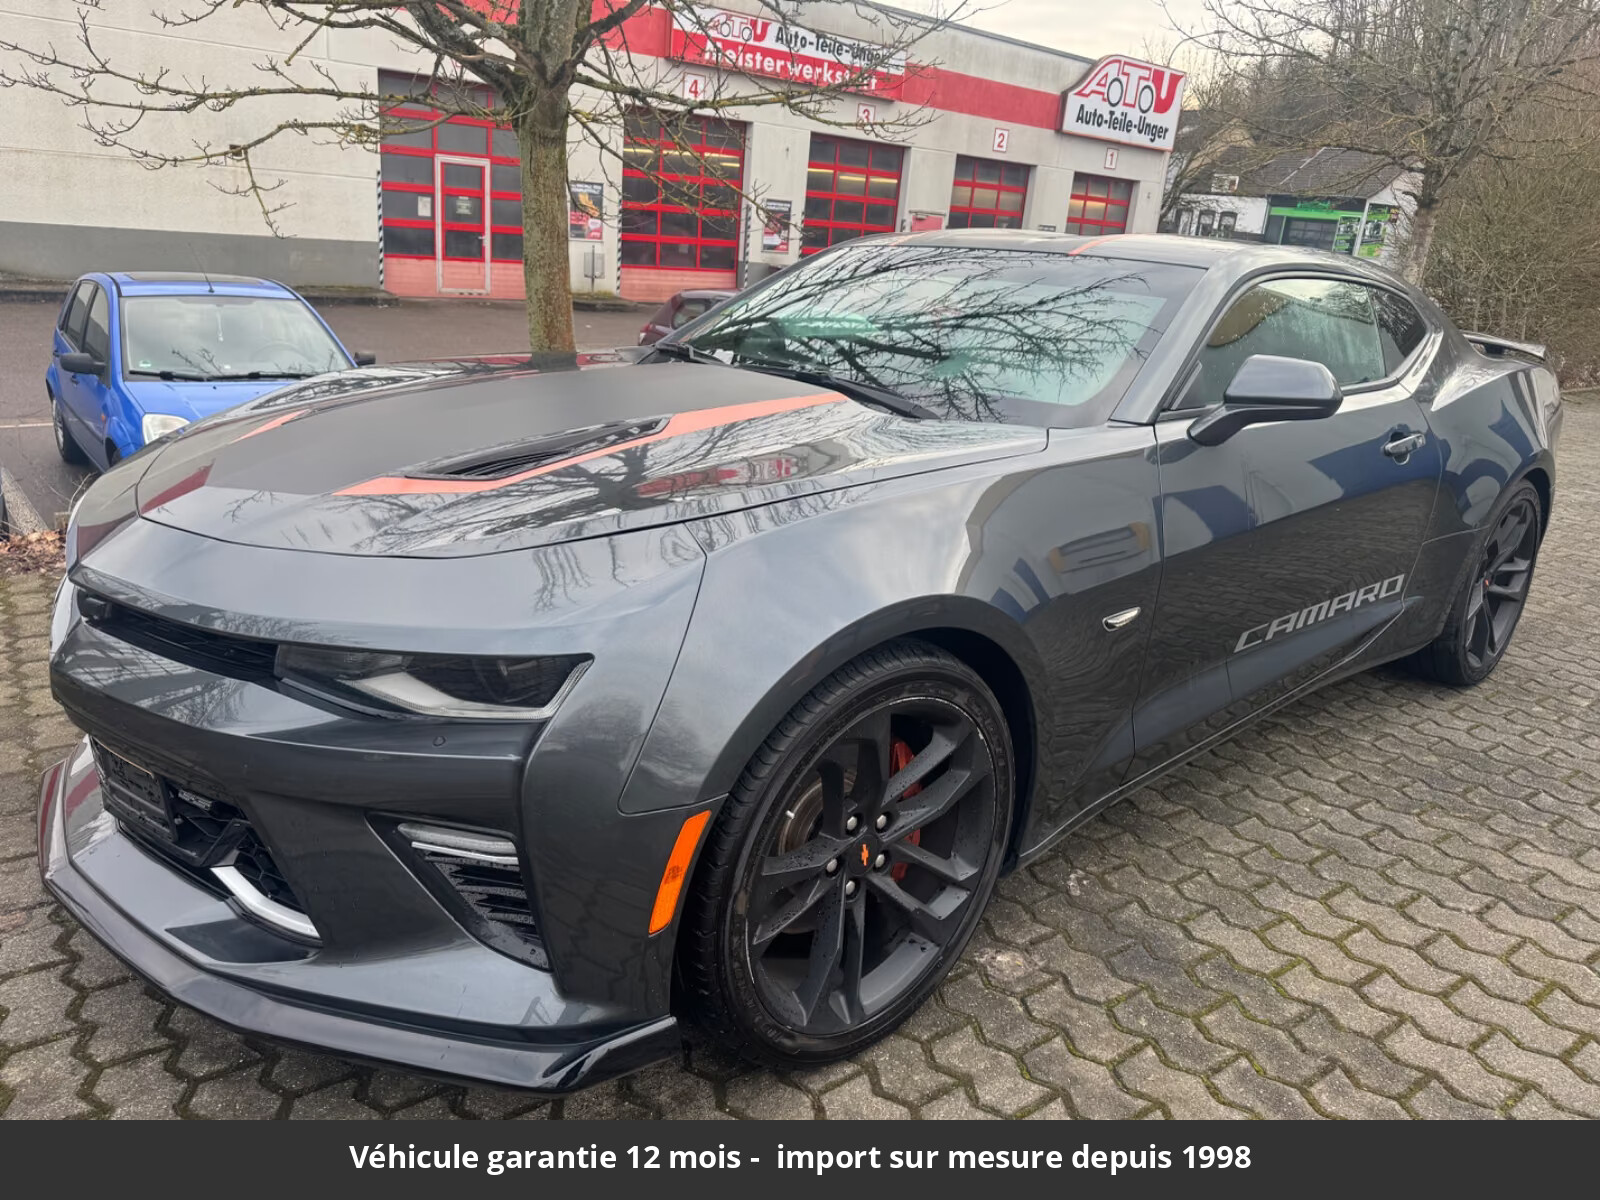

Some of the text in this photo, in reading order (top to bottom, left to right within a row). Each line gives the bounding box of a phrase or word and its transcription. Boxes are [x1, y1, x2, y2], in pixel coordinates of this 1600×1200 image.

[688, 79, 699, 97] 4
[1075, 58, 1185, 114] ATU
[862, 109, 871, 124] 3
[1075, 104, 1169, 142] Auto-Teile-Unger
[997, 132, 1005, 149] 2
[1108, 151, 1115, 167] 1
[1233, 573, 1405, 653] CAMARO
